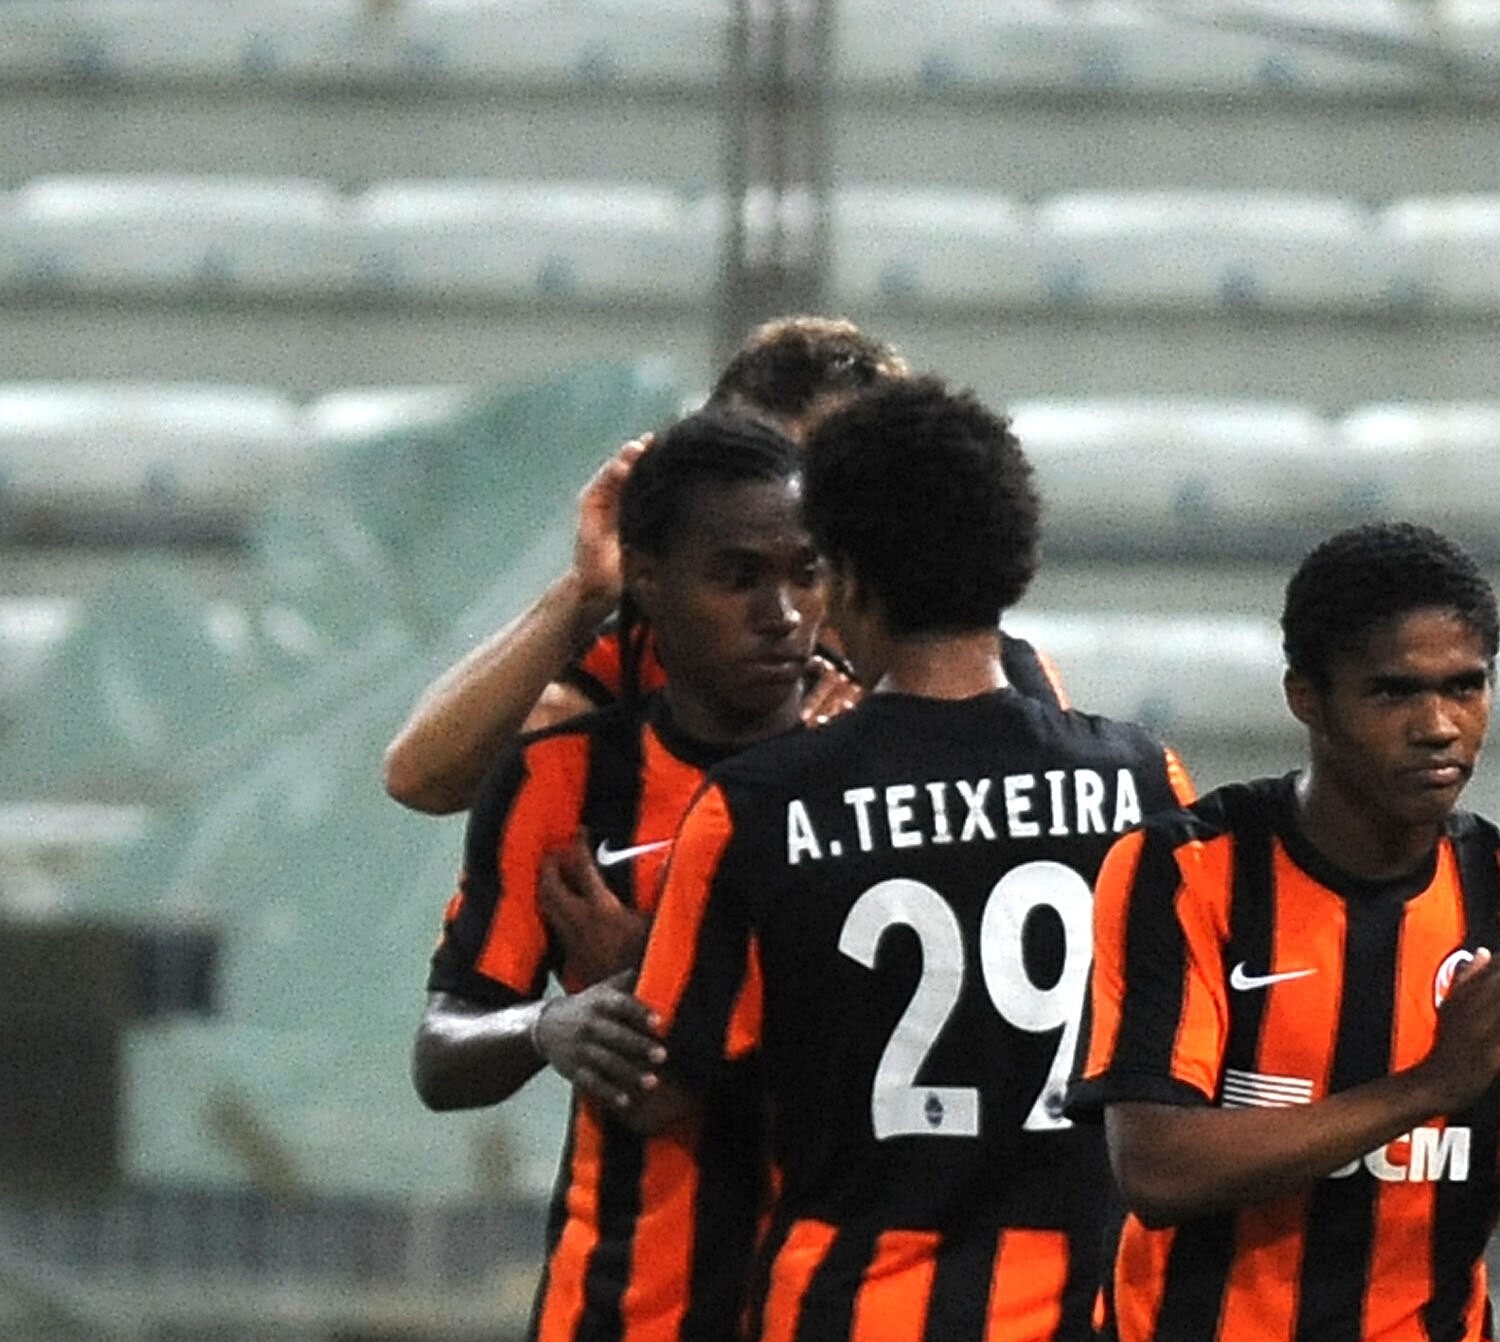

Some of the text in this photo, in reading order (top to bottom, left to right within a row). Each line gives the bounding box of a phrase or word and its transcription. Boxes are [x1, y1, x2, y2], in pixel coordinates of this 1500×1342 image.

[787, 767, 1143, 865] A.TEIXEIRA
[837, 860, 1095, 1141] 29
[1326, 1126, 1471, 1182] CM
